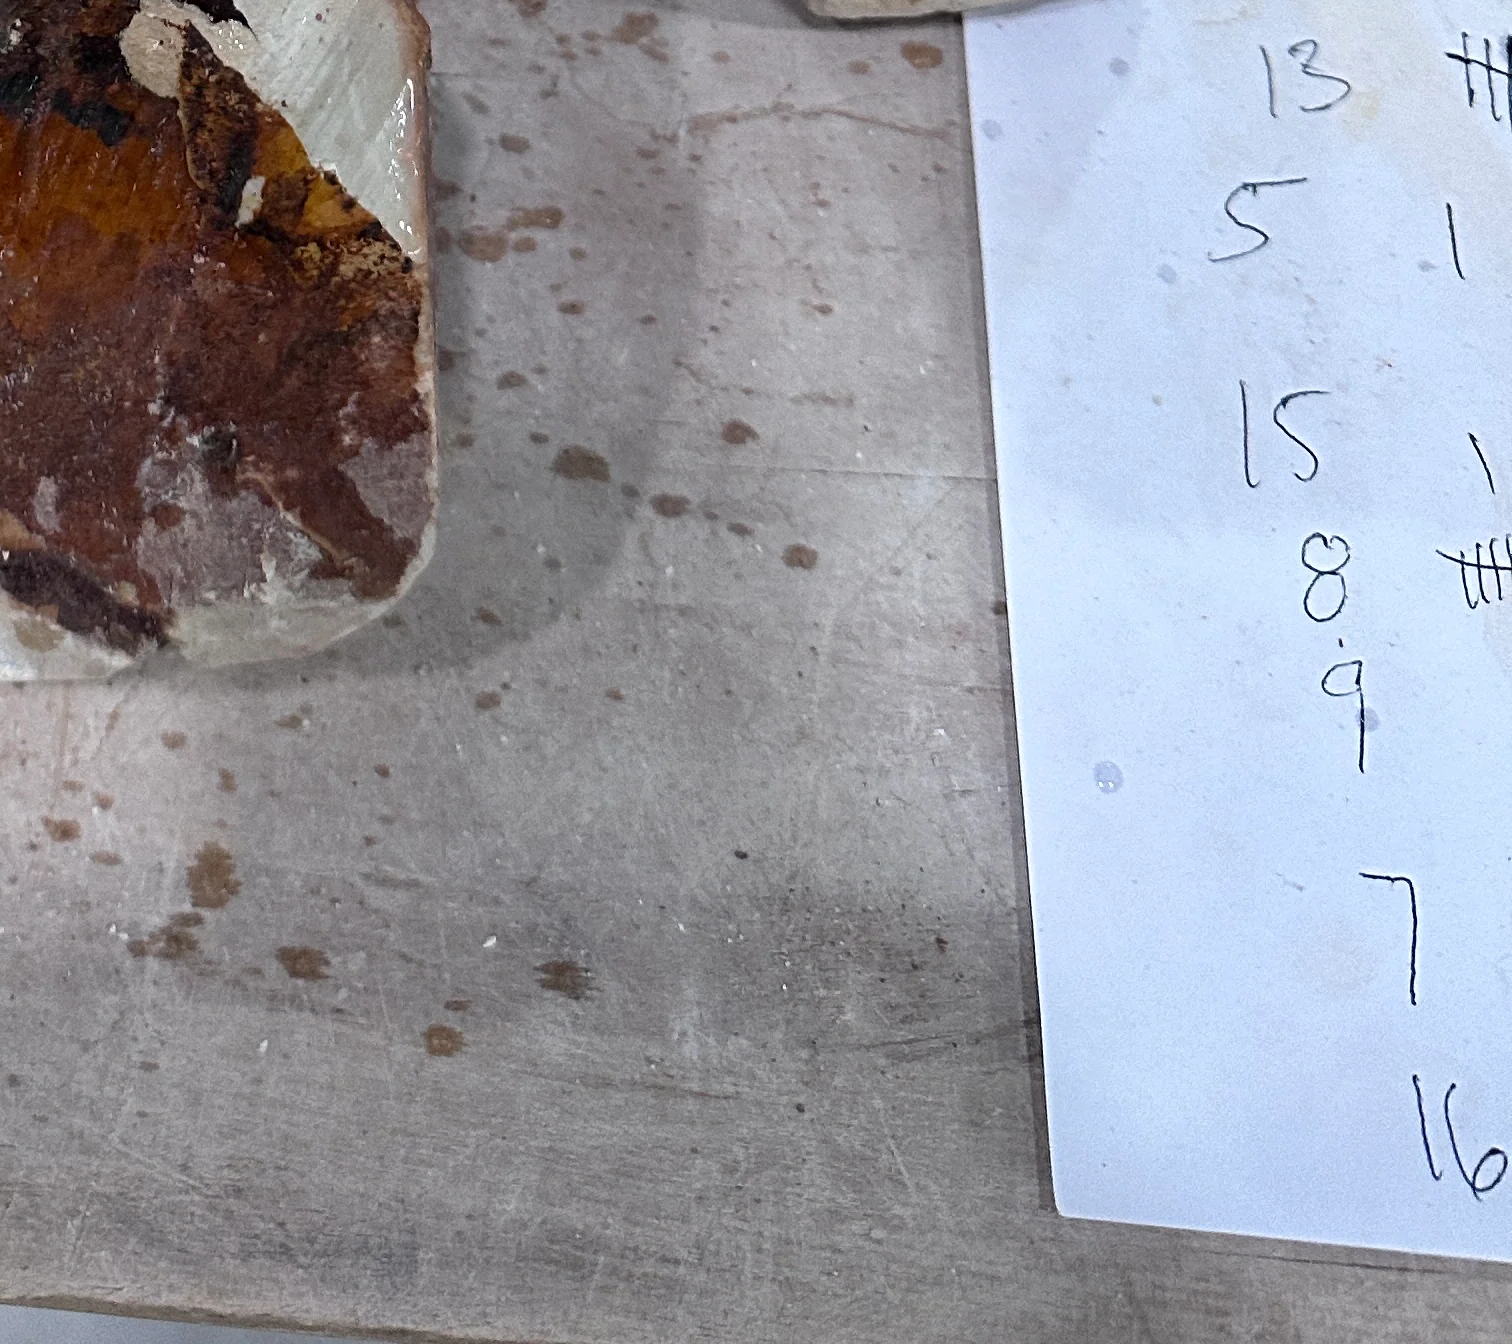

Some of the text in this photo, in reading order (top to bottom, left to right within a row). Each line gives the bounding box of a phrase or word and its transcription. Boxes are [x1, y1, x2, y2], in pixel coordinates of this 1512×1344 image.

[1259, 39, 1351, 119] 13
[1207, 177, 1308, 262] 5
[1239, 379, 1332, 488] 15
[1301, 531, 1351, 623] 8
[1320, 659, 1365, 774] 9
[1358, 871, 1418, 1005] 7
[1411, 1073, 1509, 1203] 16
